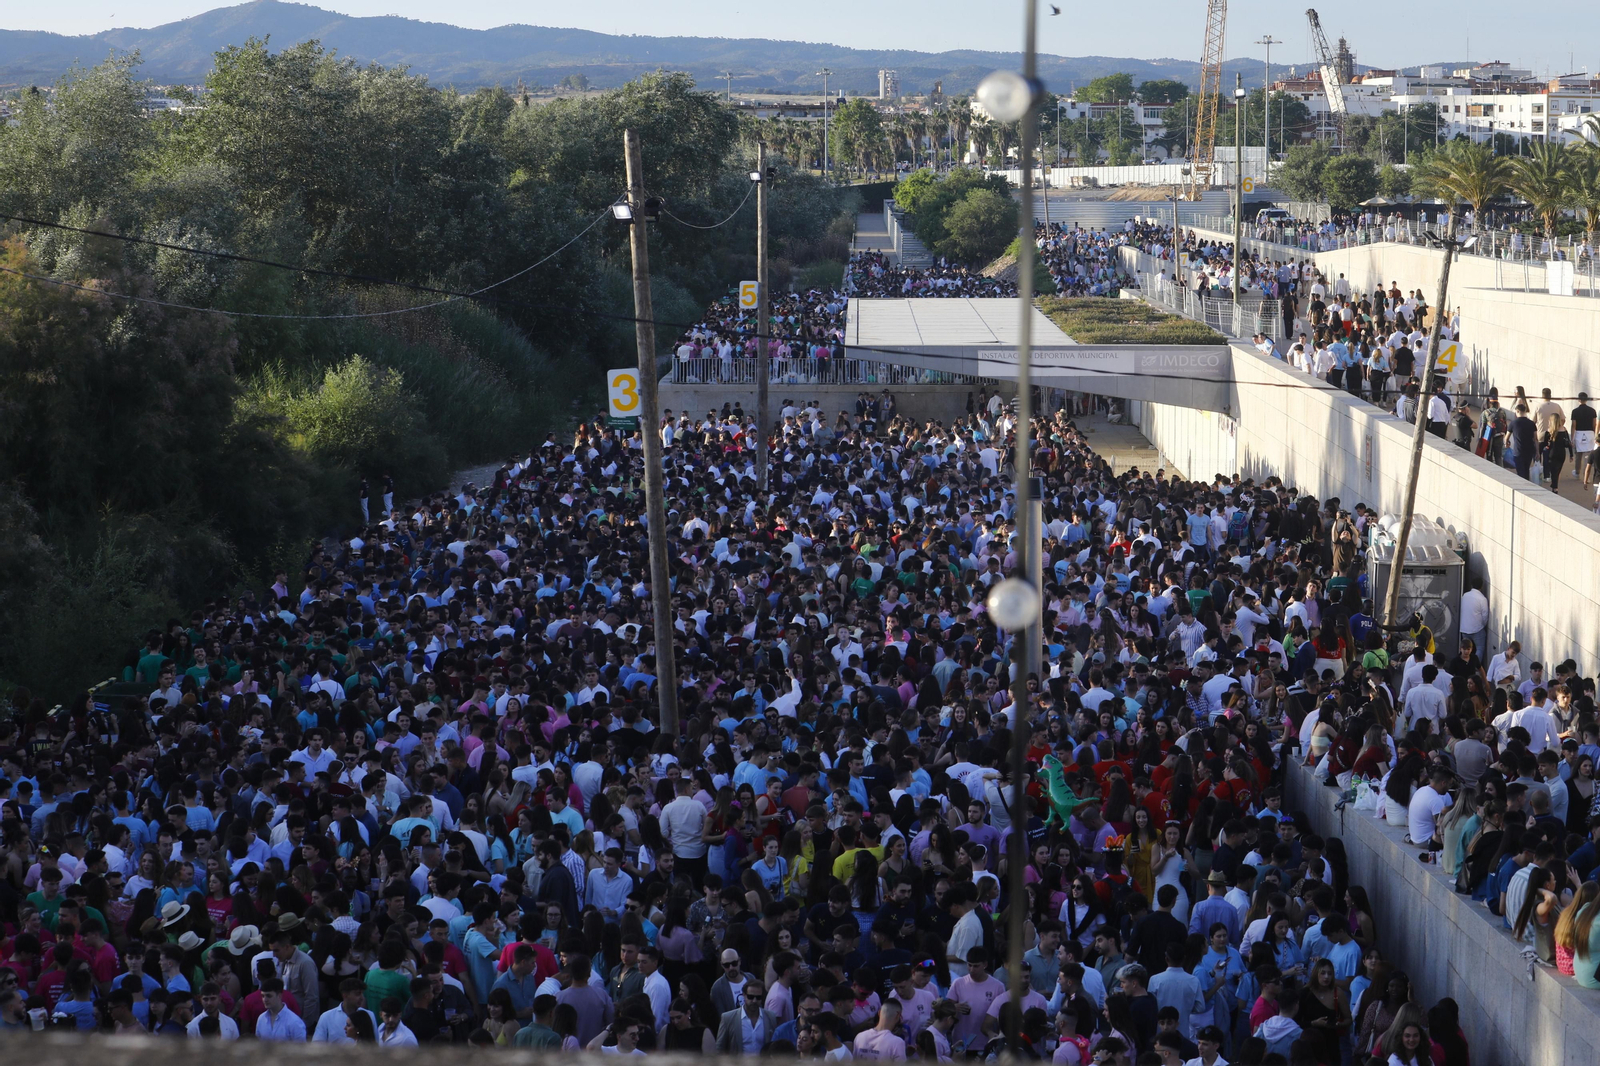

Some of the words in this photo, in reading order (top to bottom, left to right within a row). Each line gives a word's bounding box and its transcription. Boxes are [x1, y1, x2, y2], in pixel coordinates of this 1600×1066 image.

[1242, 176, 1253, 192] 6
[1180, 254, 1188, 265] 7
[741, 284, 757, 306] 5
[1160, 355, 1219, 367] IMDECO
[1437, 344, 1458, 373] 4
[612, 373, 639, 412] 3
